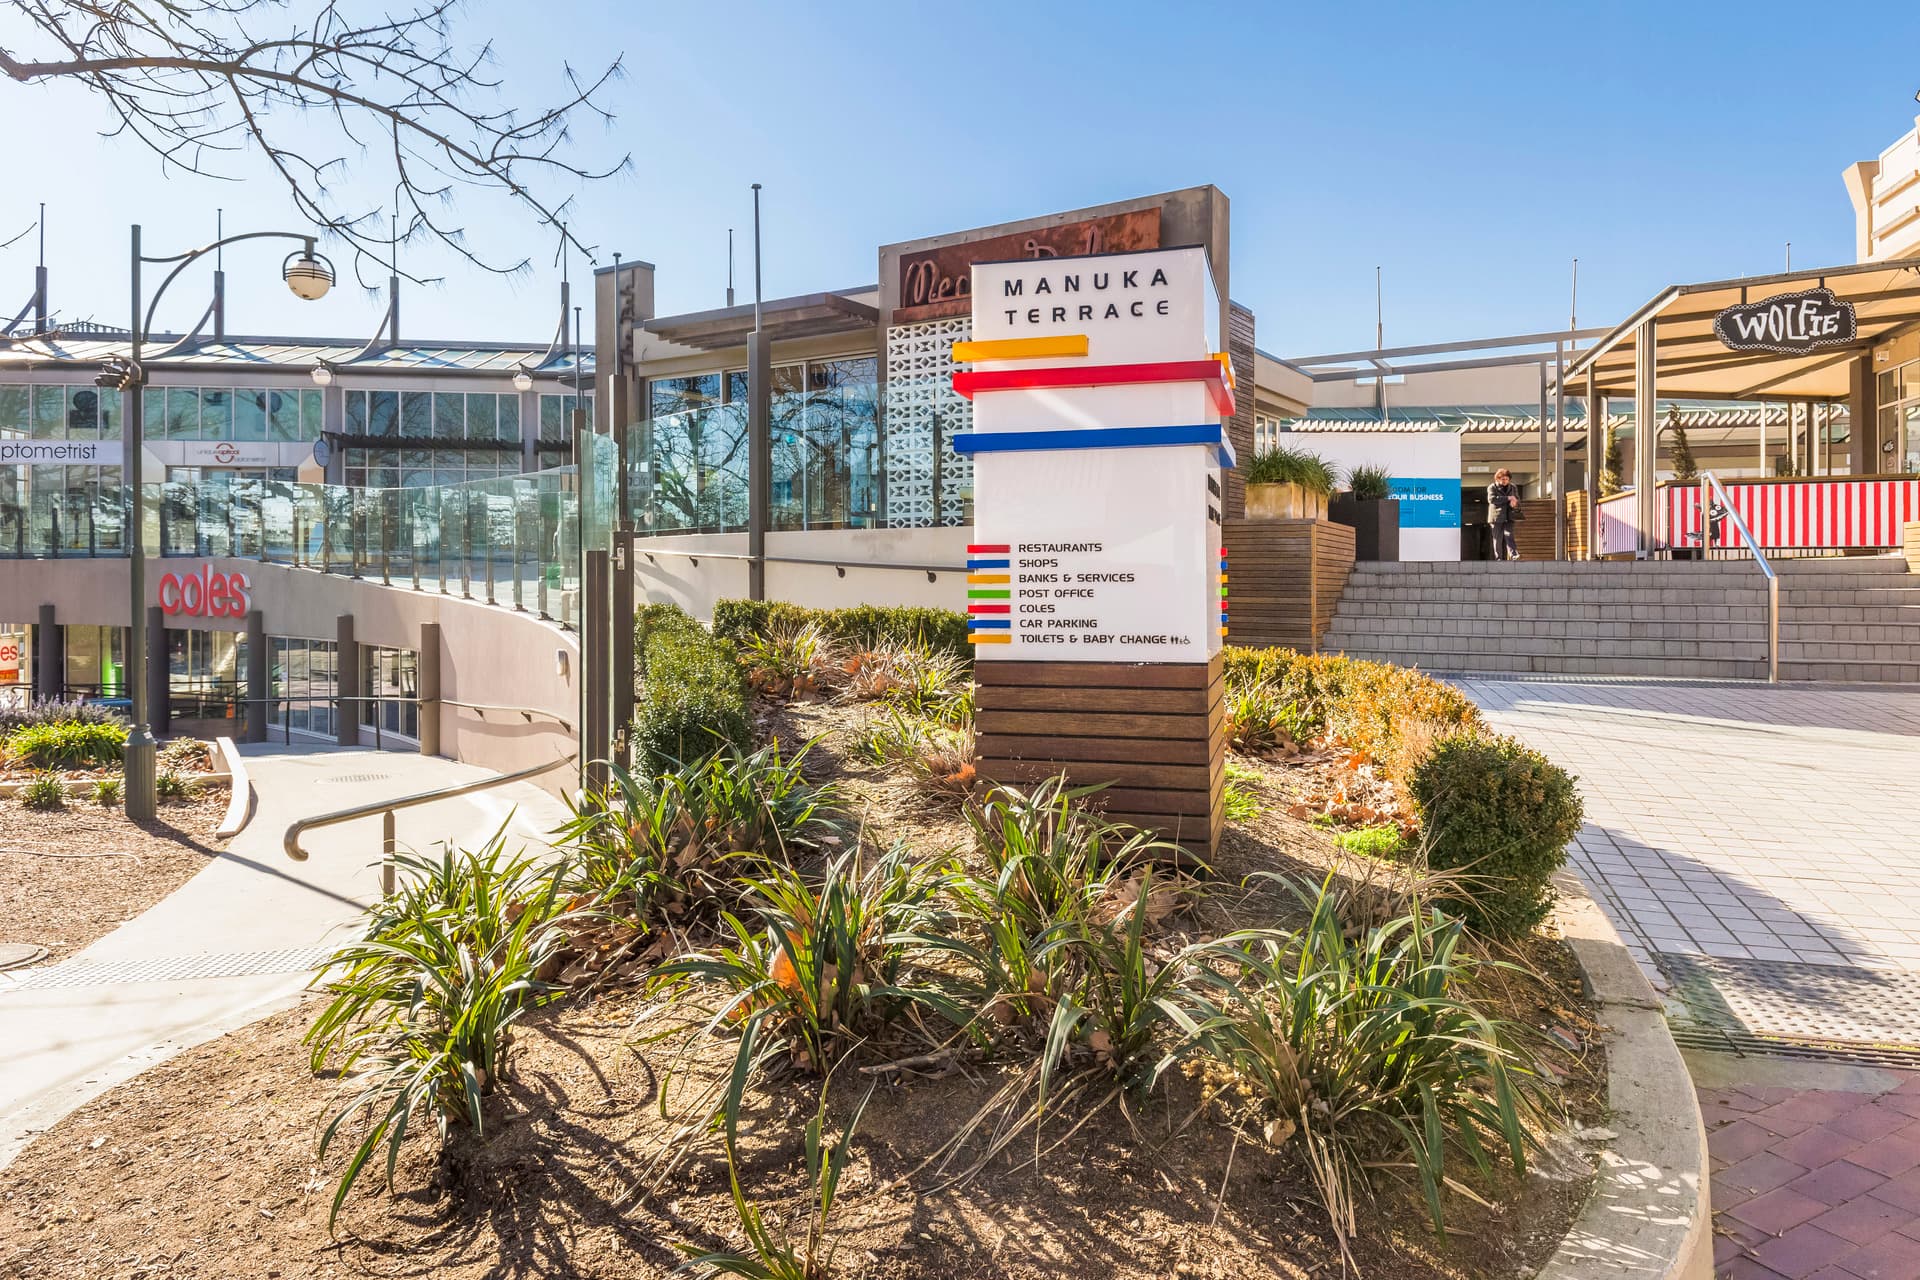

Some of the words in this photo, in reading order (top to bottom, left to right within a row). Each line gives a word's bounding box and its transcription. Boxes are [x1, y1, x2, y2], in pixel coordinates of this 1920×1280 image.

[1004, 268, 1169, 297] MANUKA
[1004, 300, 1169, 325] TERRACE
[1732, 299, 1840, 342] WOLFIE
[1, 443, 96, 461] ptometrist
[1018, 543, 1102, 553] RESTAURANTS
[1018, 558, 1058, 568] SHOPS
[1018, 574, 1058, 583] BANKS
[1063, 574, 1072, 583] &
[1077, 573, 1135, 583] SERVICES
[159, 563, 250, 617] coles
[1019, 589, 1050, 598] POST
[1054, 588, 1094, 598] OFFICE
[1019, 604, 1056, 613] COLES
[1019, 619, 1043, 629] CAR
[1047, 619, 1098, 628] PARKING
[1020, 634, 1065, 644] TOILETS
[1069, 635, 1078, 644] &
[1083, 634, 1115, 644] BABY
[1119, 635, 1167, 645] CHANGE
